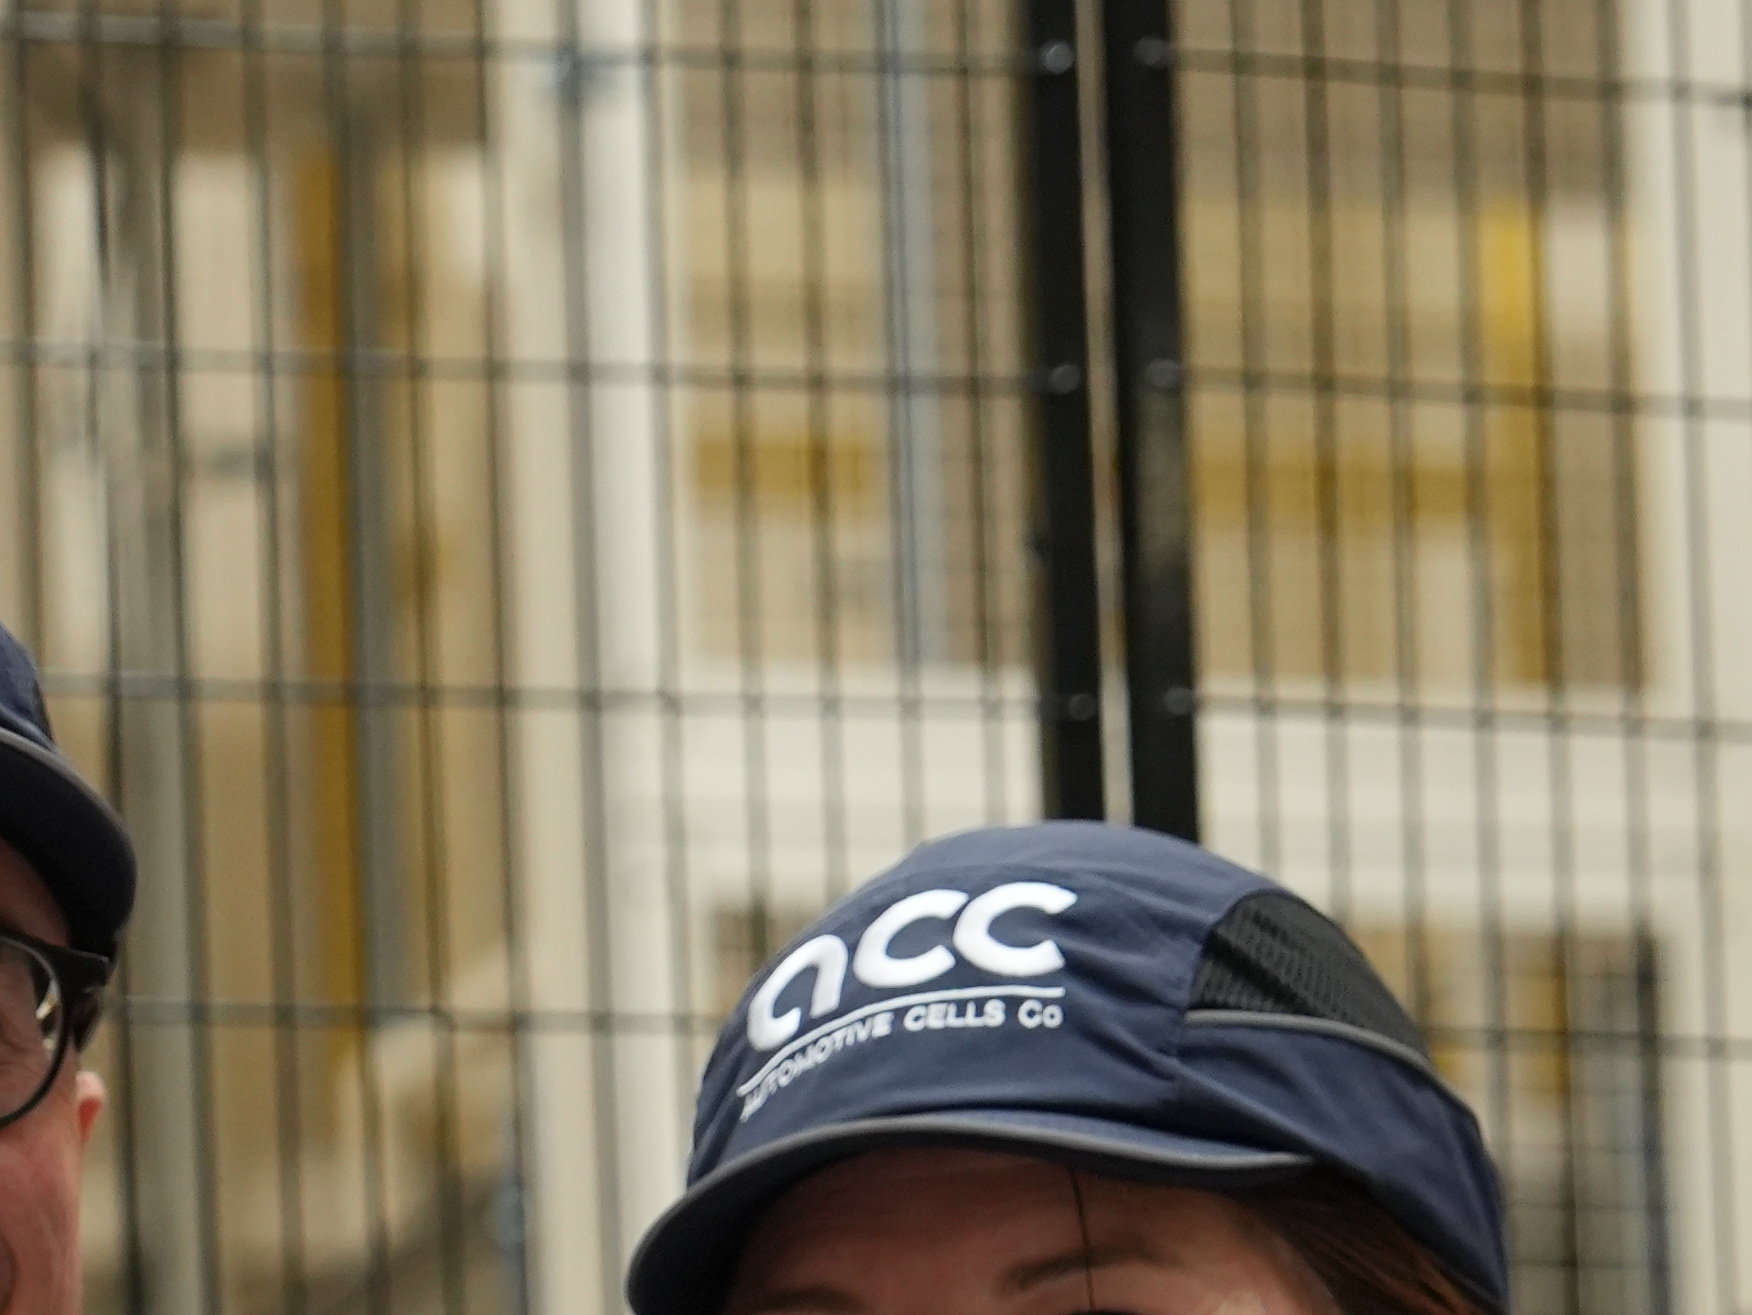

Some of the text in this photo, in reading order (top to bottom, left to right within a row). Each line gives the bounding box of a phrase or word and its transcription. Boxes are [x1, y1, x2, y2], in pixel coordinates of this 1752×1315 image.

[748, 882, 1078, 1052] acc
[740, 999, 1063, 1122] AUTOMOTIVE CELLS Co
